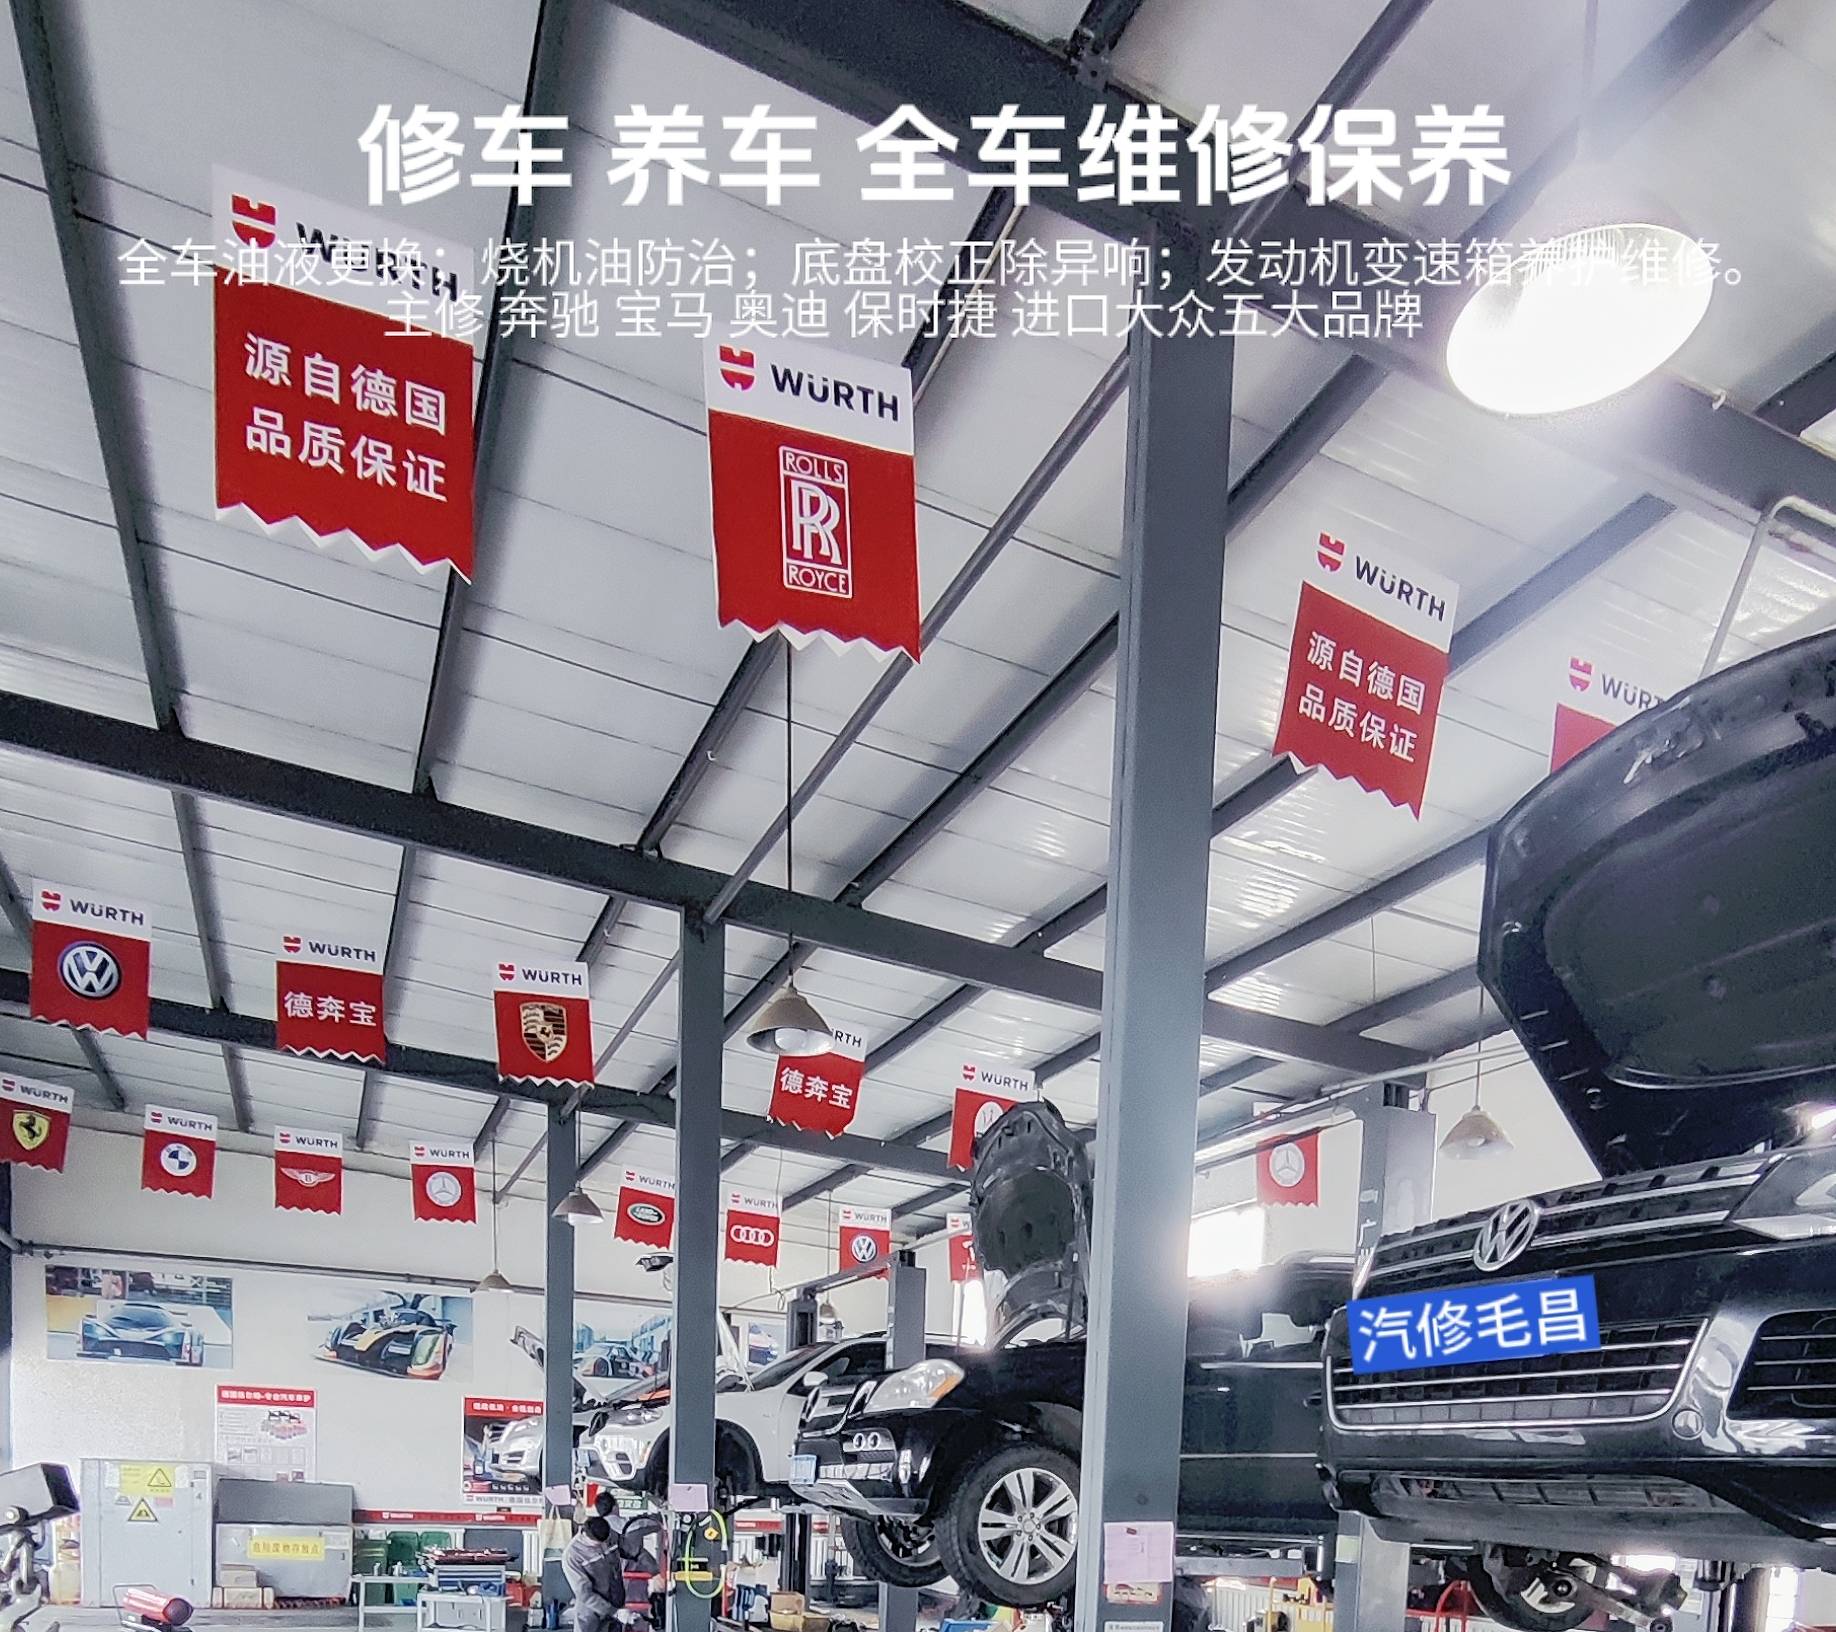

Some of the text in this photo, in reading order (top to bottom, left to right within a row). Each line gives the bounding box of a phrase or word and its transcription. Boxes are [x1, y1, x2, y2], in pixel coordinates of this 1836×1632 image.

[244, 331, 447, 436] 源自德国
[246, 406, 449, 503] 品质保证
[785, 451, 843, 483] ROLLS
[787, 563, 847, 595] ROYCE
[1306, 630, 1426, 716] 源自德国
[1298, 682, 1419, 763] 品质保证
[283, 990, 377, 1027] 德奔宝
[831, 1028, 863, 1048] RTH
[780, 1066, 853, 1110] 德奔宝
